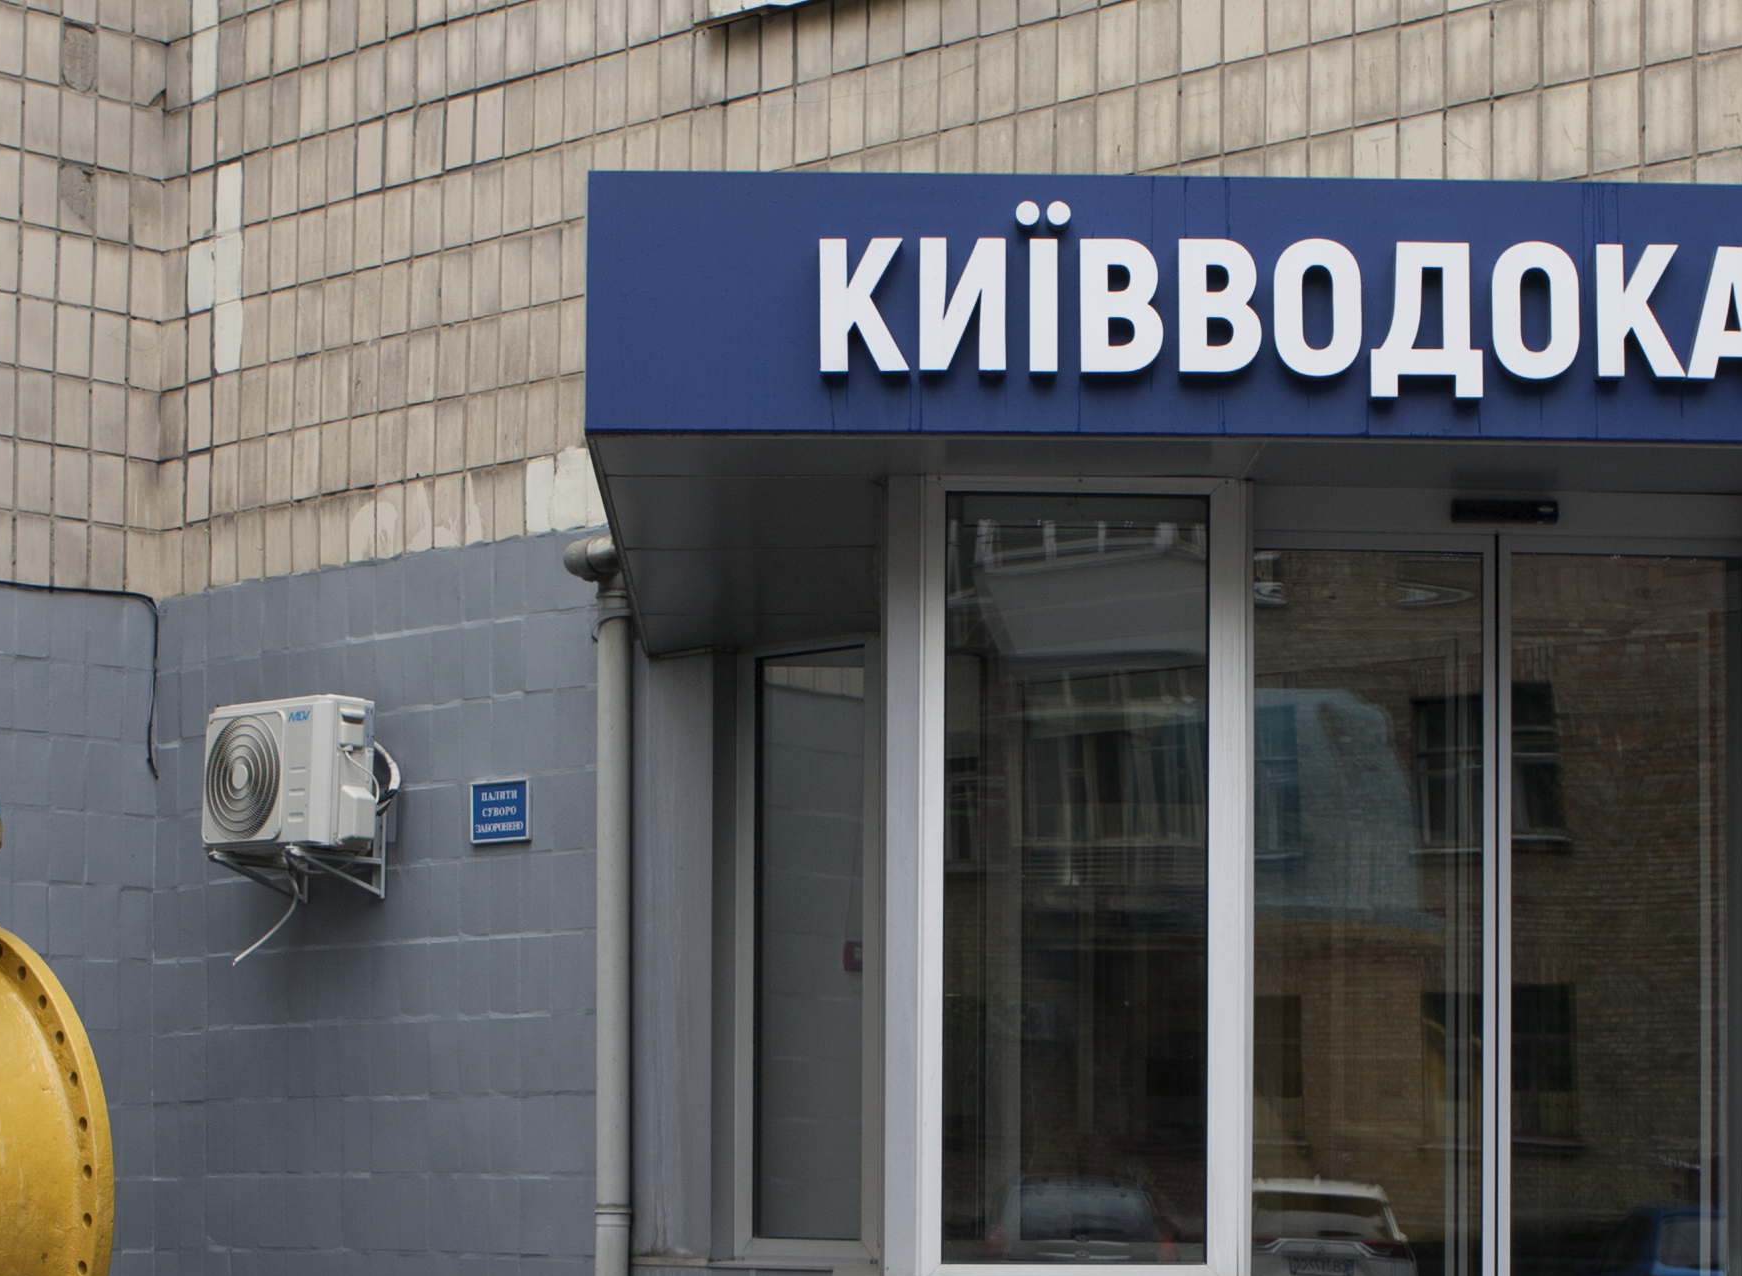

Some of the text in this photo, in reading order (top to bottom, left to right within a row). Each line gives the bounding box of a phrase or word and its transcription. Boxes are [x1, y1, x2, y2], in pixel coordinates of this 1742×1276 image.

[287, 710, 310, 722] MDV
[481, 789, 518, 802] ПАЛИТИ
[482, 805, 517, 818] СУВОРО
[475, 820, 524, 834] ЗАБОРОНЕНО
